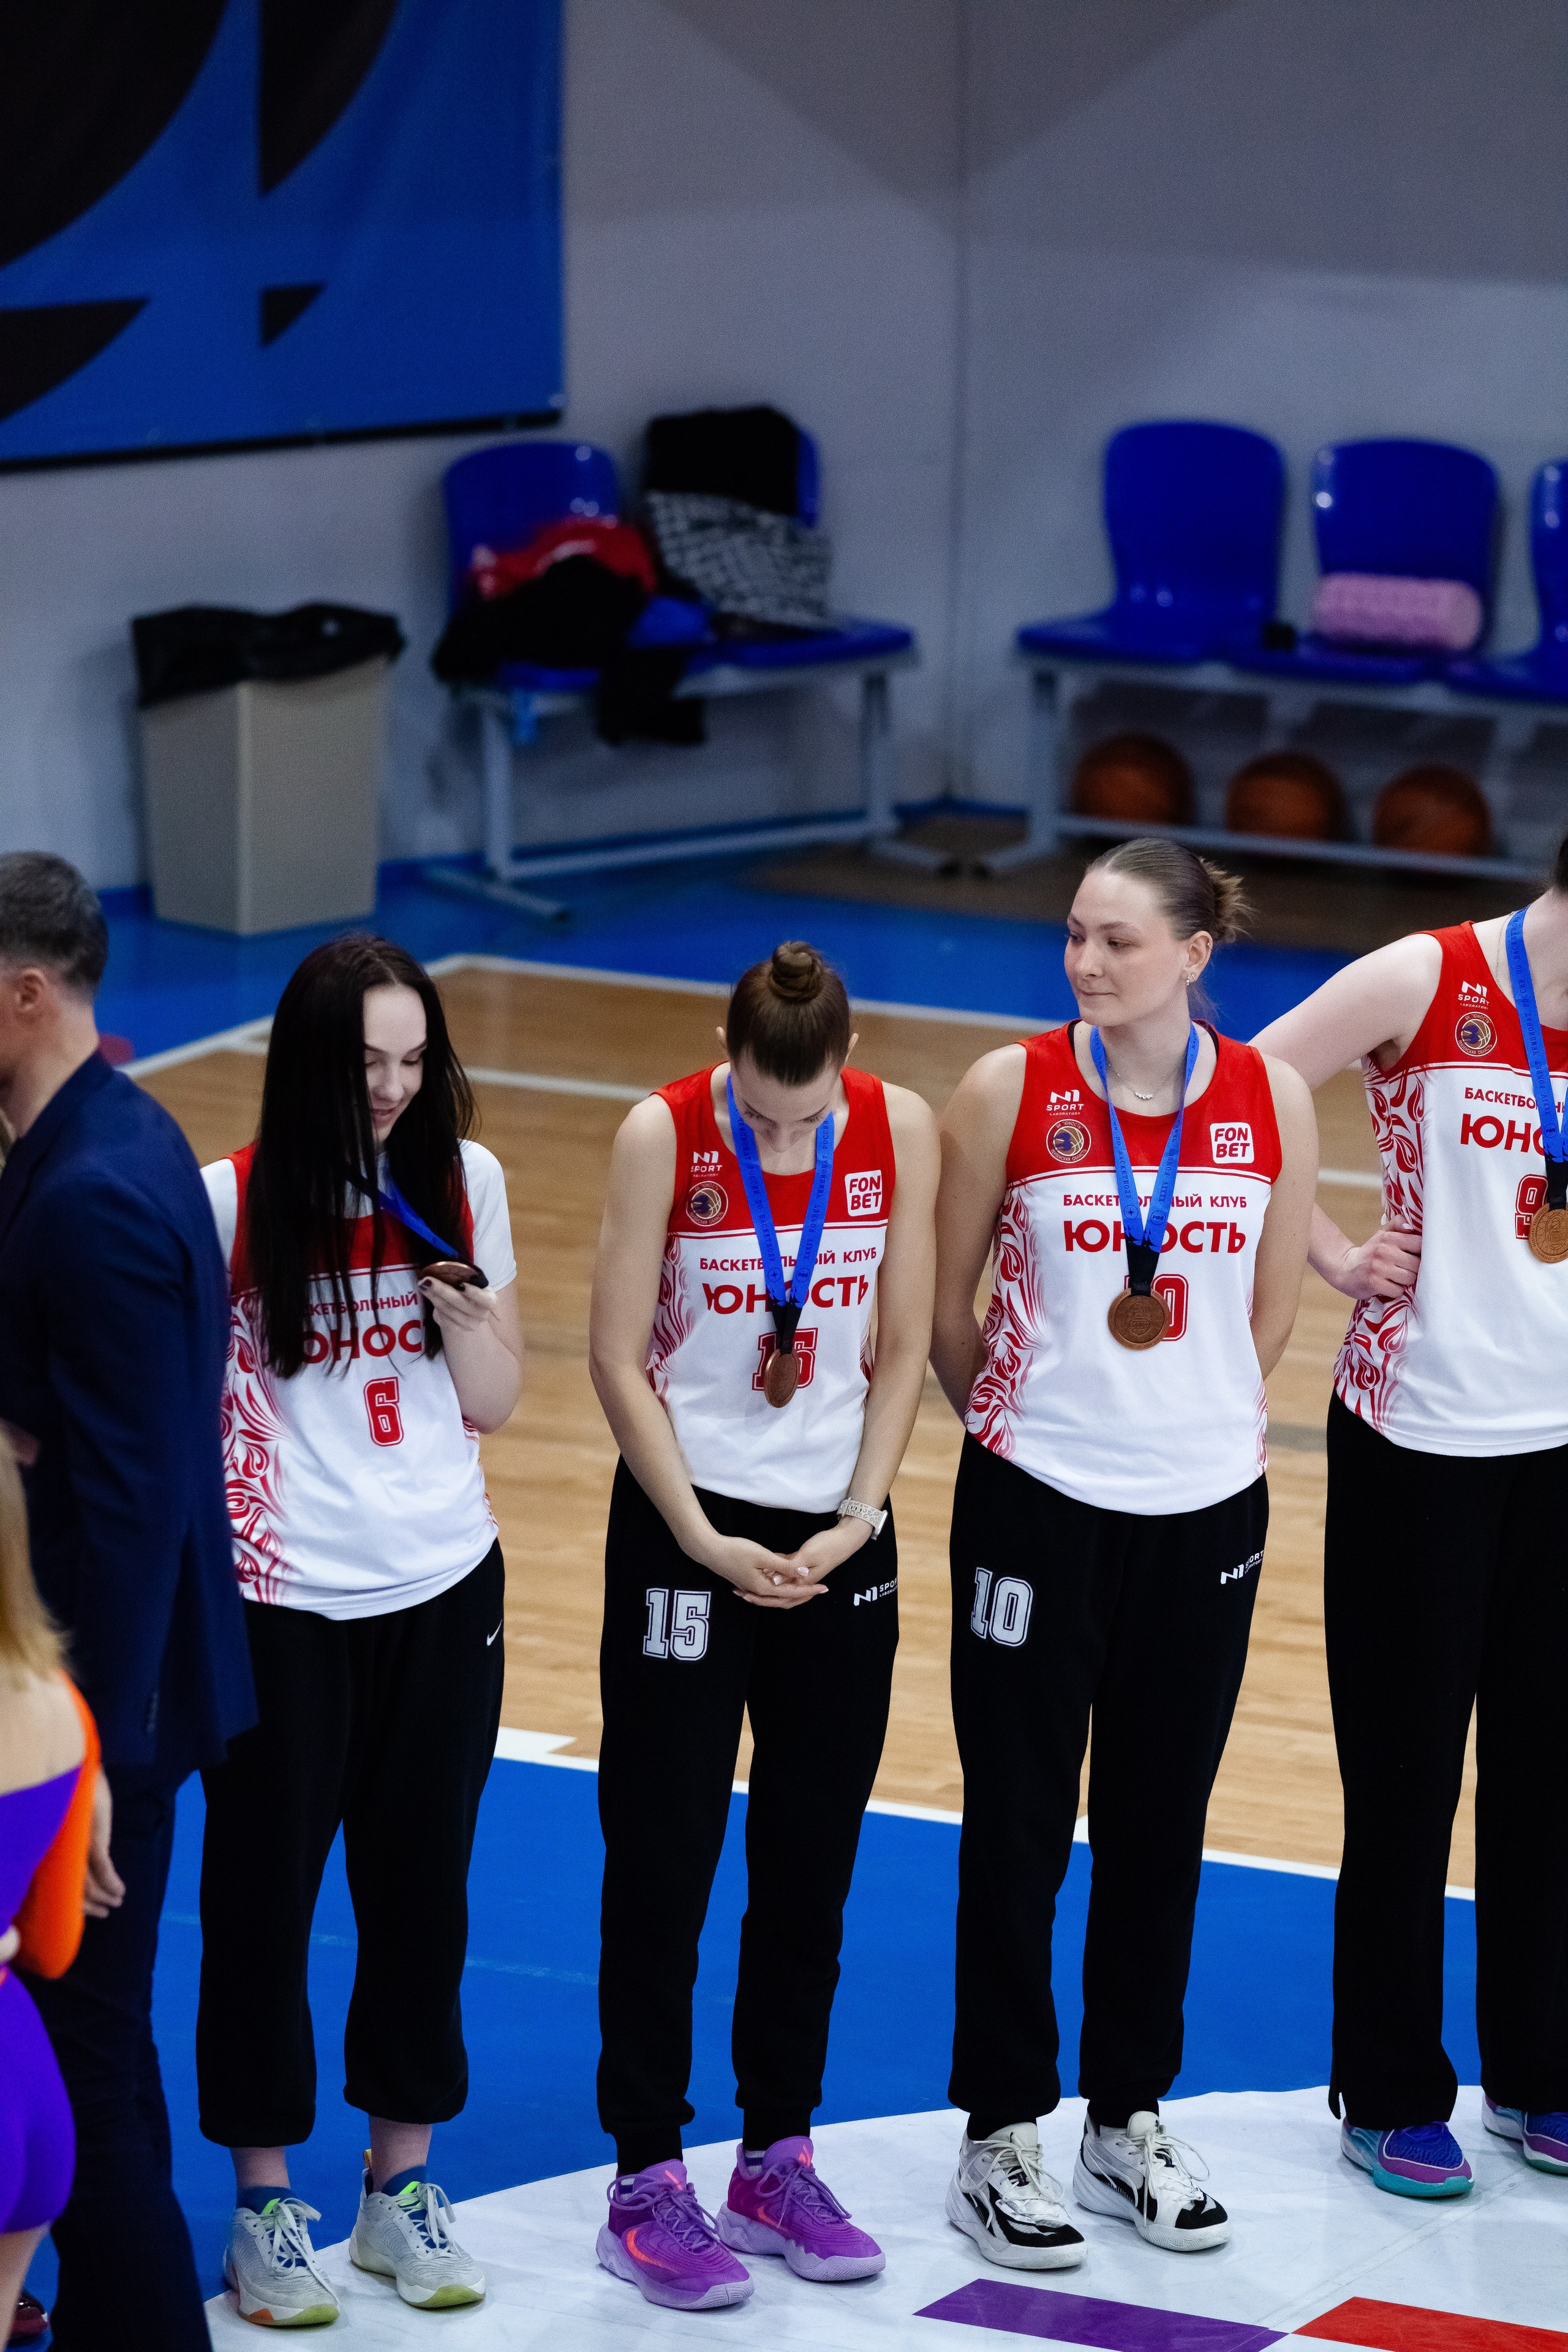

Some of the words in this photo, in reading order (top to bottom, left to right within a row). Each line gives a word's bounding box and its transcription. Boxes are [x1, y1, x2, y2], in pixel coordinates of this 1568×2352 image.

[1458, 993, 1490, 1006] SPORT
[1050, 1089, 1080, 1103] N1
[1215, 1128, 1248, 1142] FON
[1216, 1143, 1250, 1158] BET
[850, 1175, 881, 1193] FON
[851, 1192, 881, 1210] BET
[1210, 1196, 1247, 1208] КЛУБ
[843, 1247, 876, 1263] КЛУБ
[1125, 1273, 1189, 1341] 0
[363, 1376, 404, 1447] 6
[1221, 1564, 1244, 1585] N1
[880, 1577, 897, 1592] SPOR
[854, 1586, 877, 1606] N1
[971, 1567, 1033, 1646] 10
[643, 1588, 711, 1661] 15
